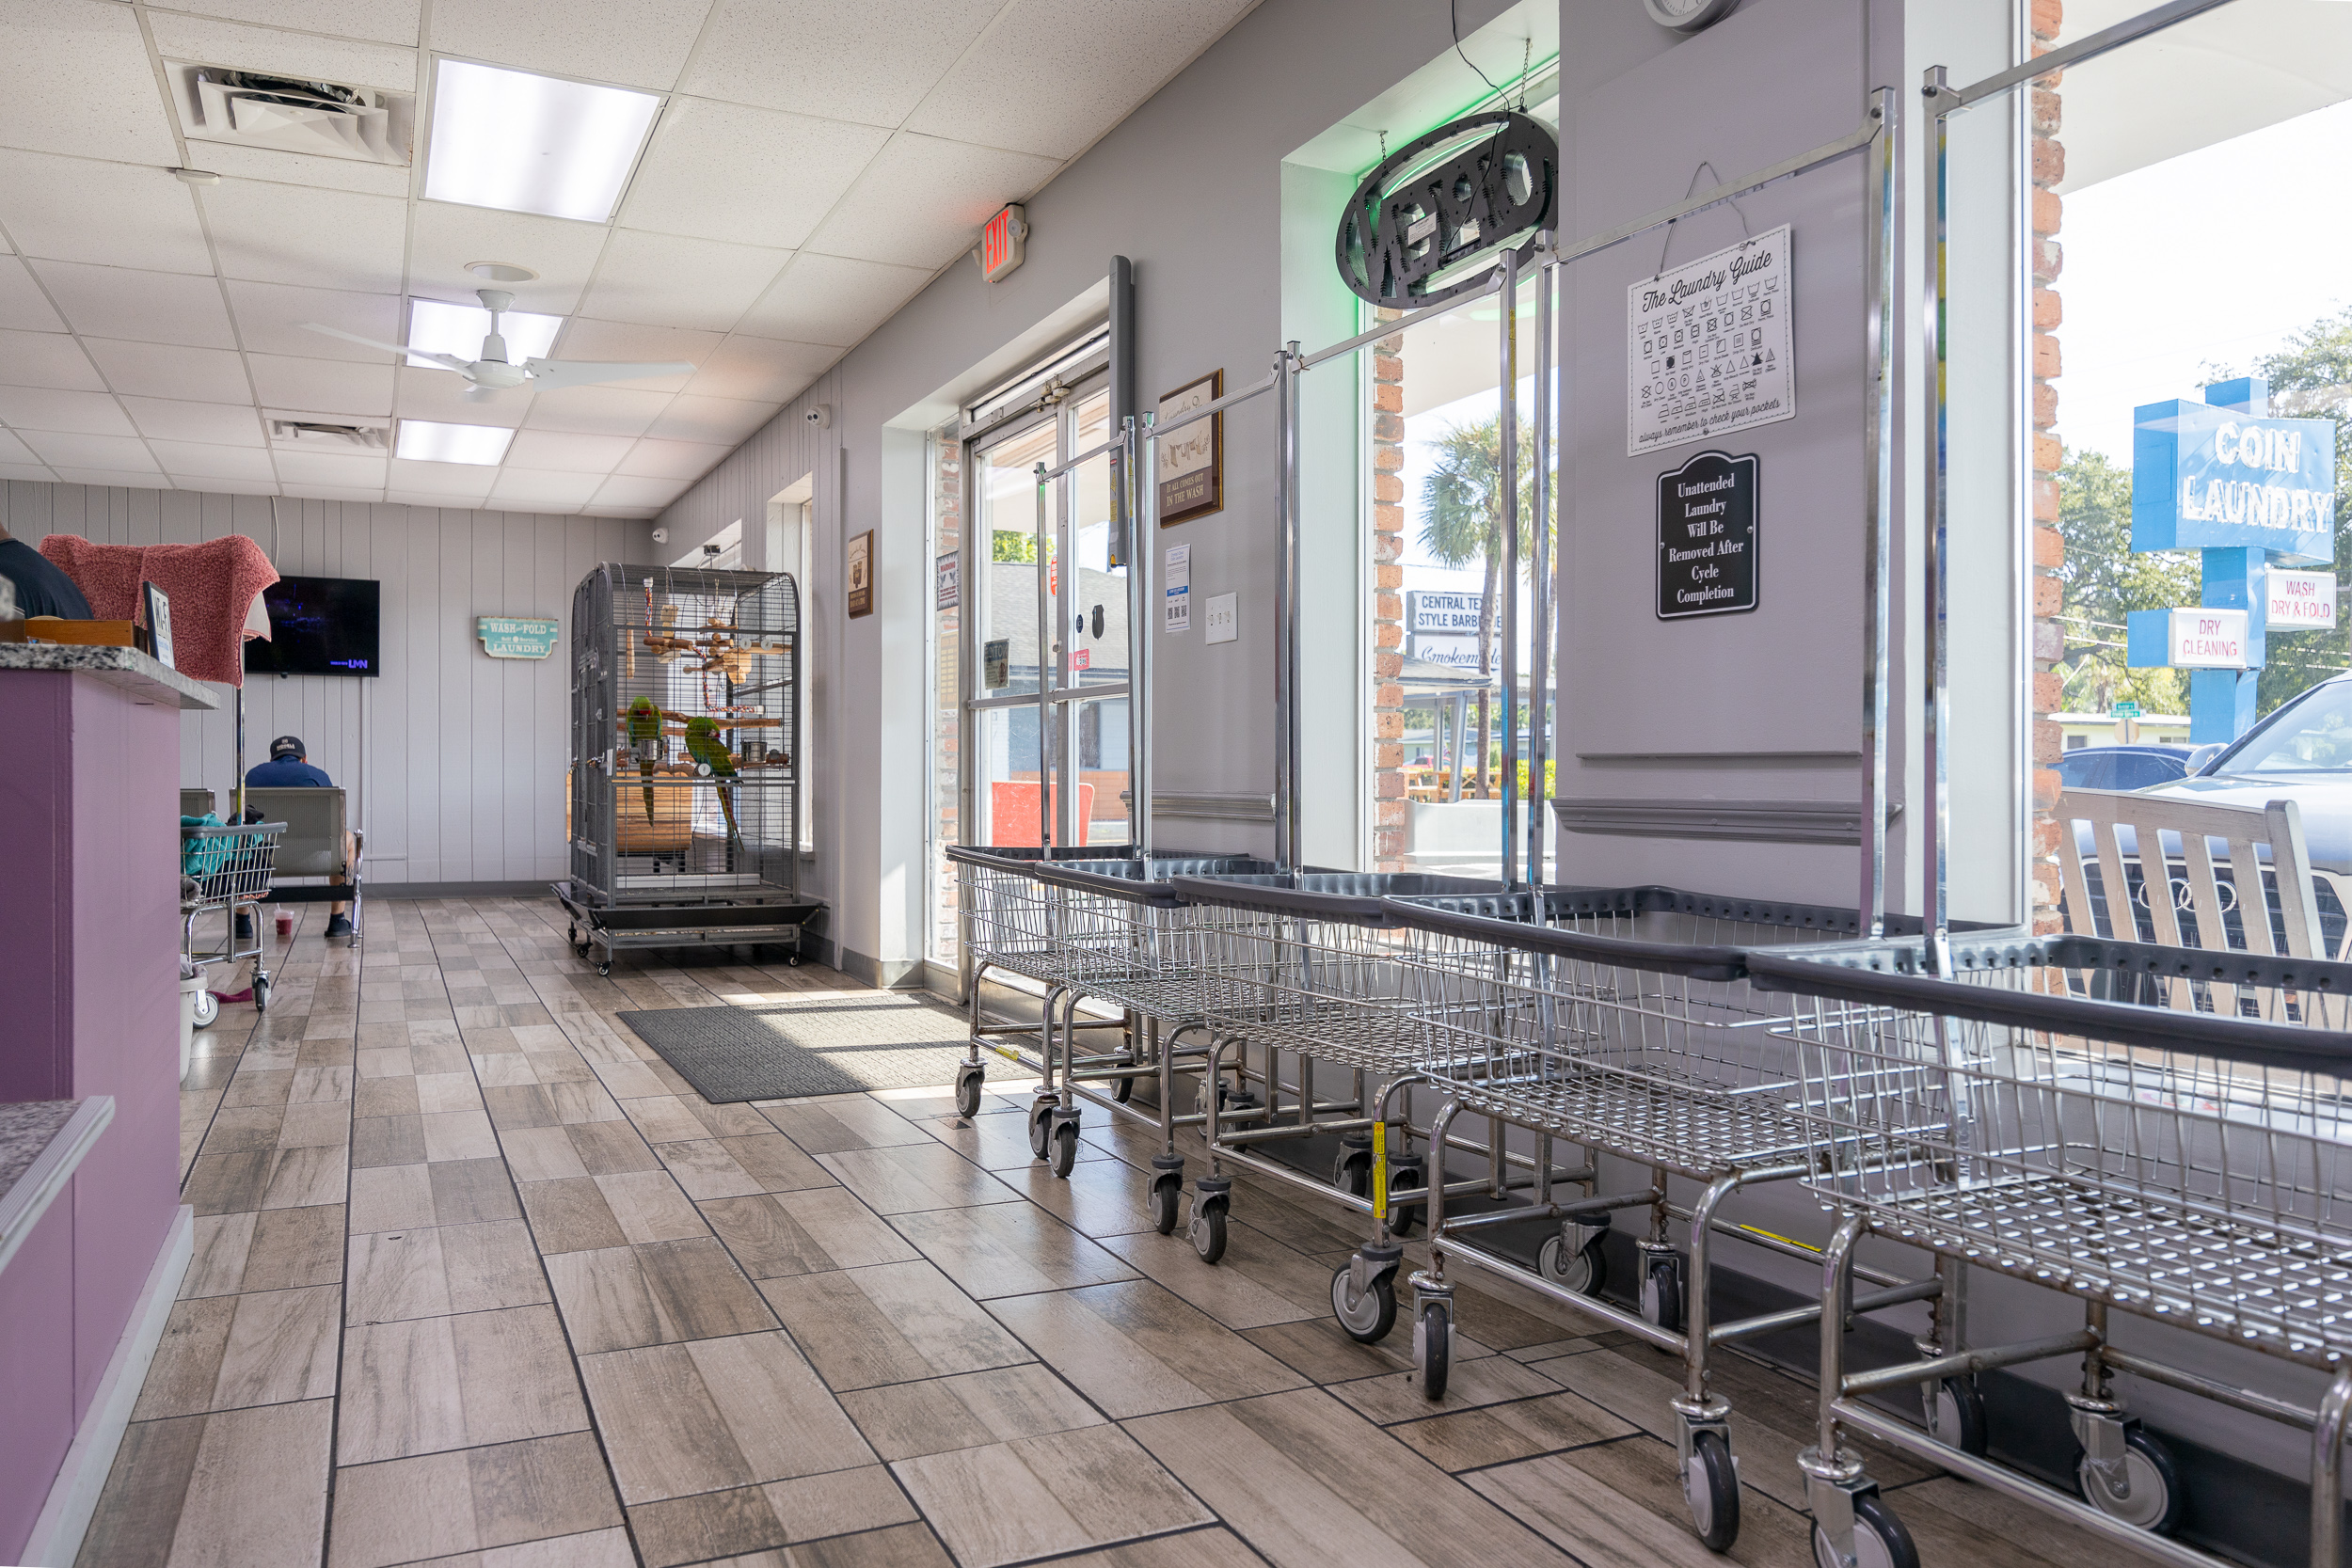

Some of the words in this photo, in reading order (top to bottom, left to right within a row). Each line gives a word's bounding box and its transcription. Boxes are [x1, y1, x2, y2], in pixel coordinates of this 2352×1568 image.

[986, 210, 1009, 274] EXIT
[1643, 291, 1667, 312] The
[1668, 270, 1727, 305] Laundry
[1730, 250, 1772, 285] Guide
[1639, 431, 1662, 443] always
[1664, 421, 1699, 436] remember
[1700, 418, 1708, 428] to
[1708, 412, 1730, 425] check
[1731, 408, 1750, 423] your
[1750, 398, 1781, 416] pockets
[2215, 421, 2301, 473] COIN
[1180, 476, 1195, 488] COMES
[1195, 472, 1204, 483] OUT
[1677, 472, 1735, 498] Unattended
[1167, 495, 1173, 507] IN
[1174, 490, 1185, 504] THE
[1186, 484, 1204, 500] WASH
[2183, 475, 2334, 533] LAUNDRY
[1685, 499, 1726, 517] Laundry
[1687, 521, 1708, 538] Will
[1709, 520, 1724, 535] Be
[1668, 542, 1714, 562] Removed
[1717, 539, 1744, 555] After
[1692, 563, 1719, 583] Cycle
[1677, 585, 1735, 605] Completion
[2286, 580, 2315, 596] WASH
[1422, 595, 1465, 610] CENTRAL
[2271, 600, 2291, 615] DRY
[2294, 602, 2301, 617] &
[2303, 602, 2330, 618] FOLD
[490, 623, 516, 633] WASH
[523, 624, 547, 634] FOLD
[1419, 613, 1448, 626] STYLE
[2200, 619, 2221, 636] DRY
[493, 644, 546, 653] LAUNDRY
[2183, 640, 2237, 657] CLEANING
[348, 658, 368, 669] LMN
